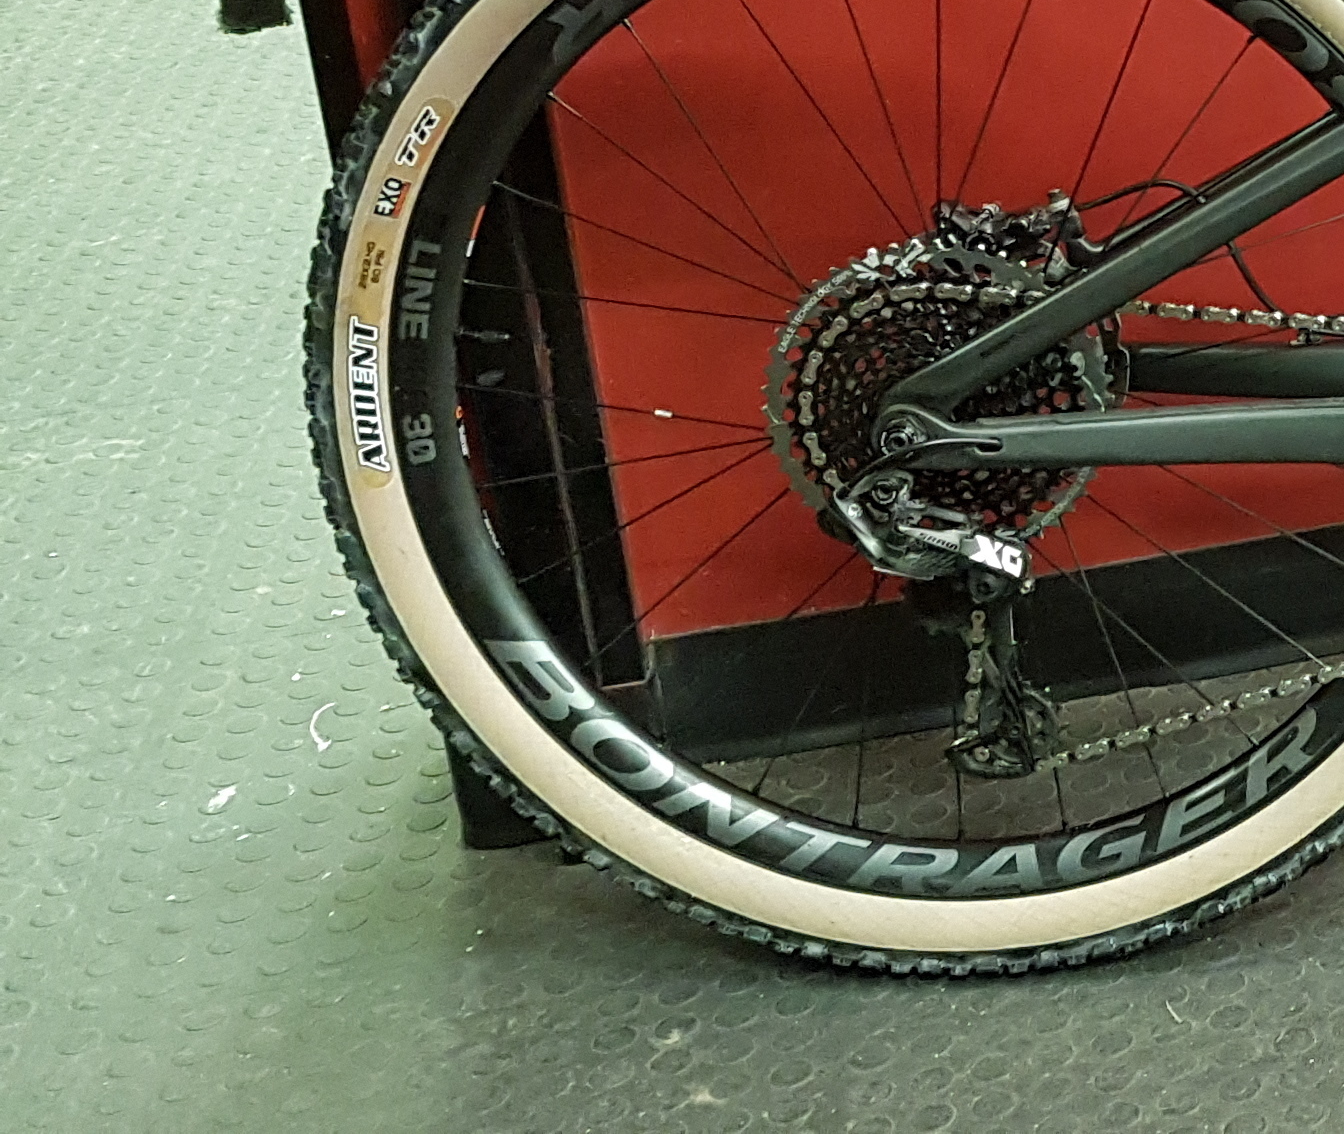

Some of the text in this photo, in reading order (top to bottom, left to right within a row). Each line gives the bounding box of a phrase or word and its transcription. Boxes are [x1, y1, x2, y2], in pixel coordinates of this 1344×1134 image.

[373, 105, 440, 217] EXO TR
[348, 314, 390, 472] ARDENT
[401, 239, 442, 466] LINE 30
[919, 533, 959, 550] SRAM
[484, 639, 1316, 895] BONTRAGER
